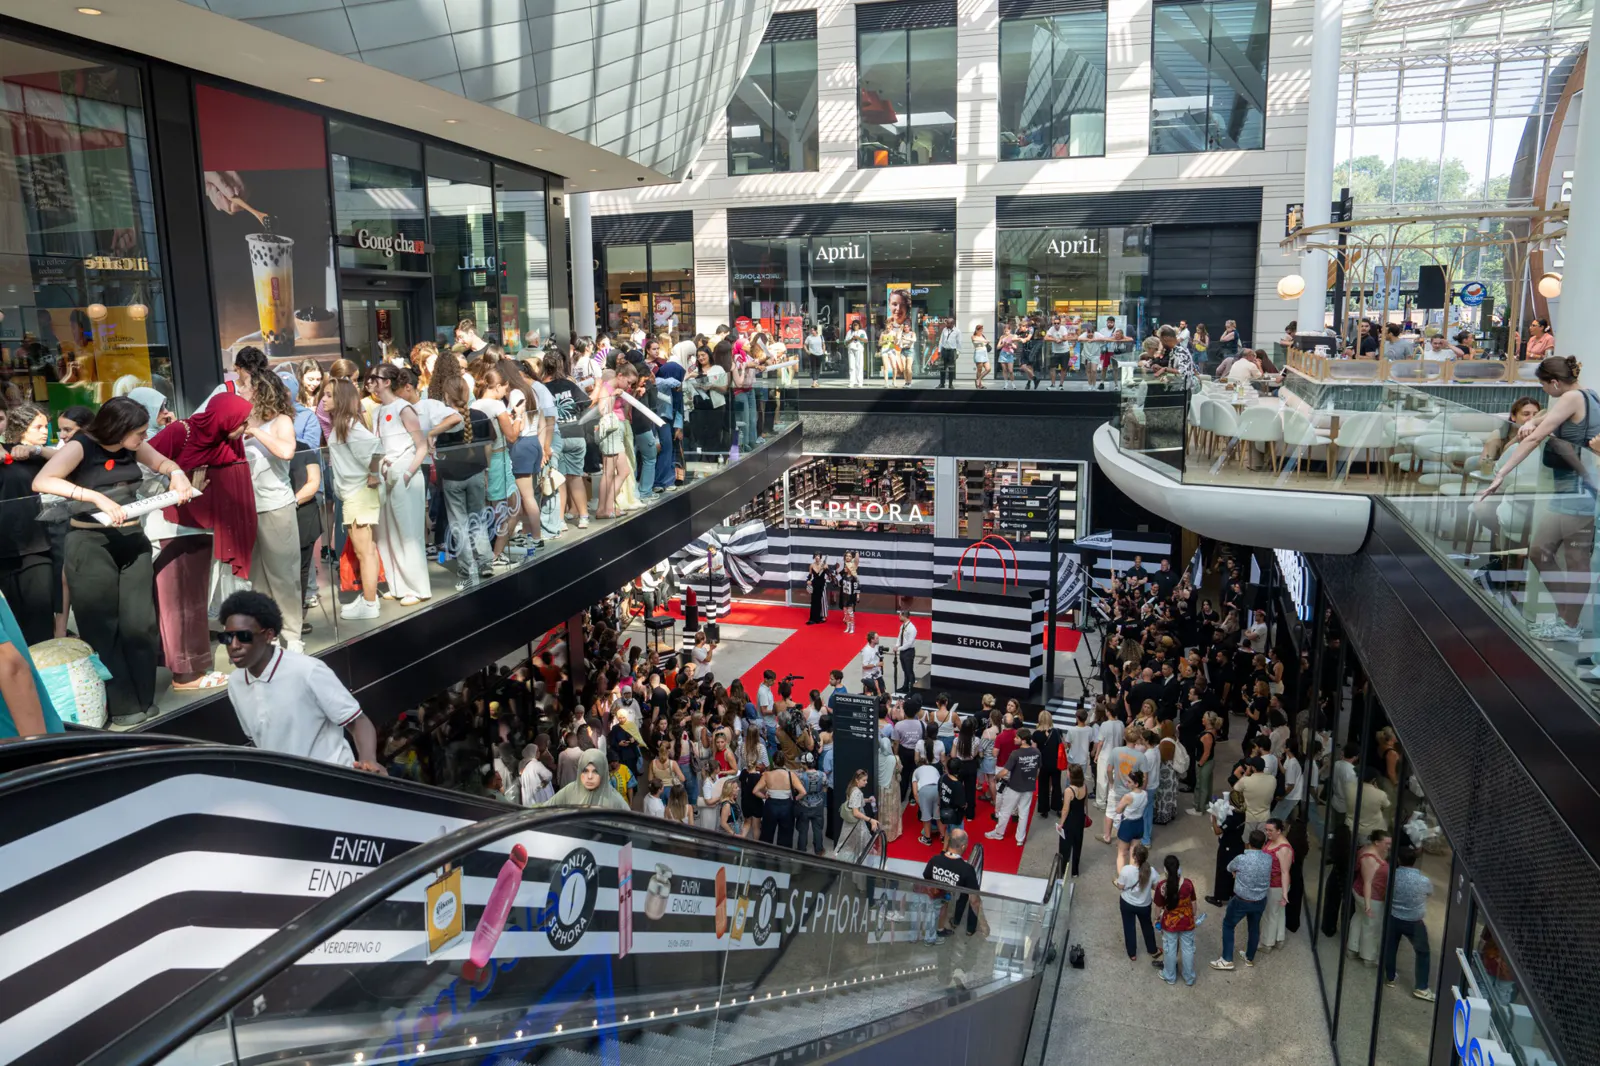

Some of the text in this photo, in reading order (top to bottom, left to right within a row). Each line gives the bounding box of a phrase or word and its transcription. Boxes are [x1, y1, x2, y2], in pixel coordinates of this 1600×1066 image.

[358, 229, 393, 257] Gong
[394, 233, 415, 253] cha
[795, 499, 924, 523] SEPHORA
[957, 637, 1003, 650] SEPHORA
[330, 836, 385, 864] ENFIN
[561, 852, 597, 880] ONLY AT
[932, 865, 960, 882] DOCKS
[785, 889, 869, 935] SEPHORA
[547, 915, 588, 945] SEPHORA
[323, 941, 374, 954] VERDIEPING
[375, 942, 382, 954] 0
